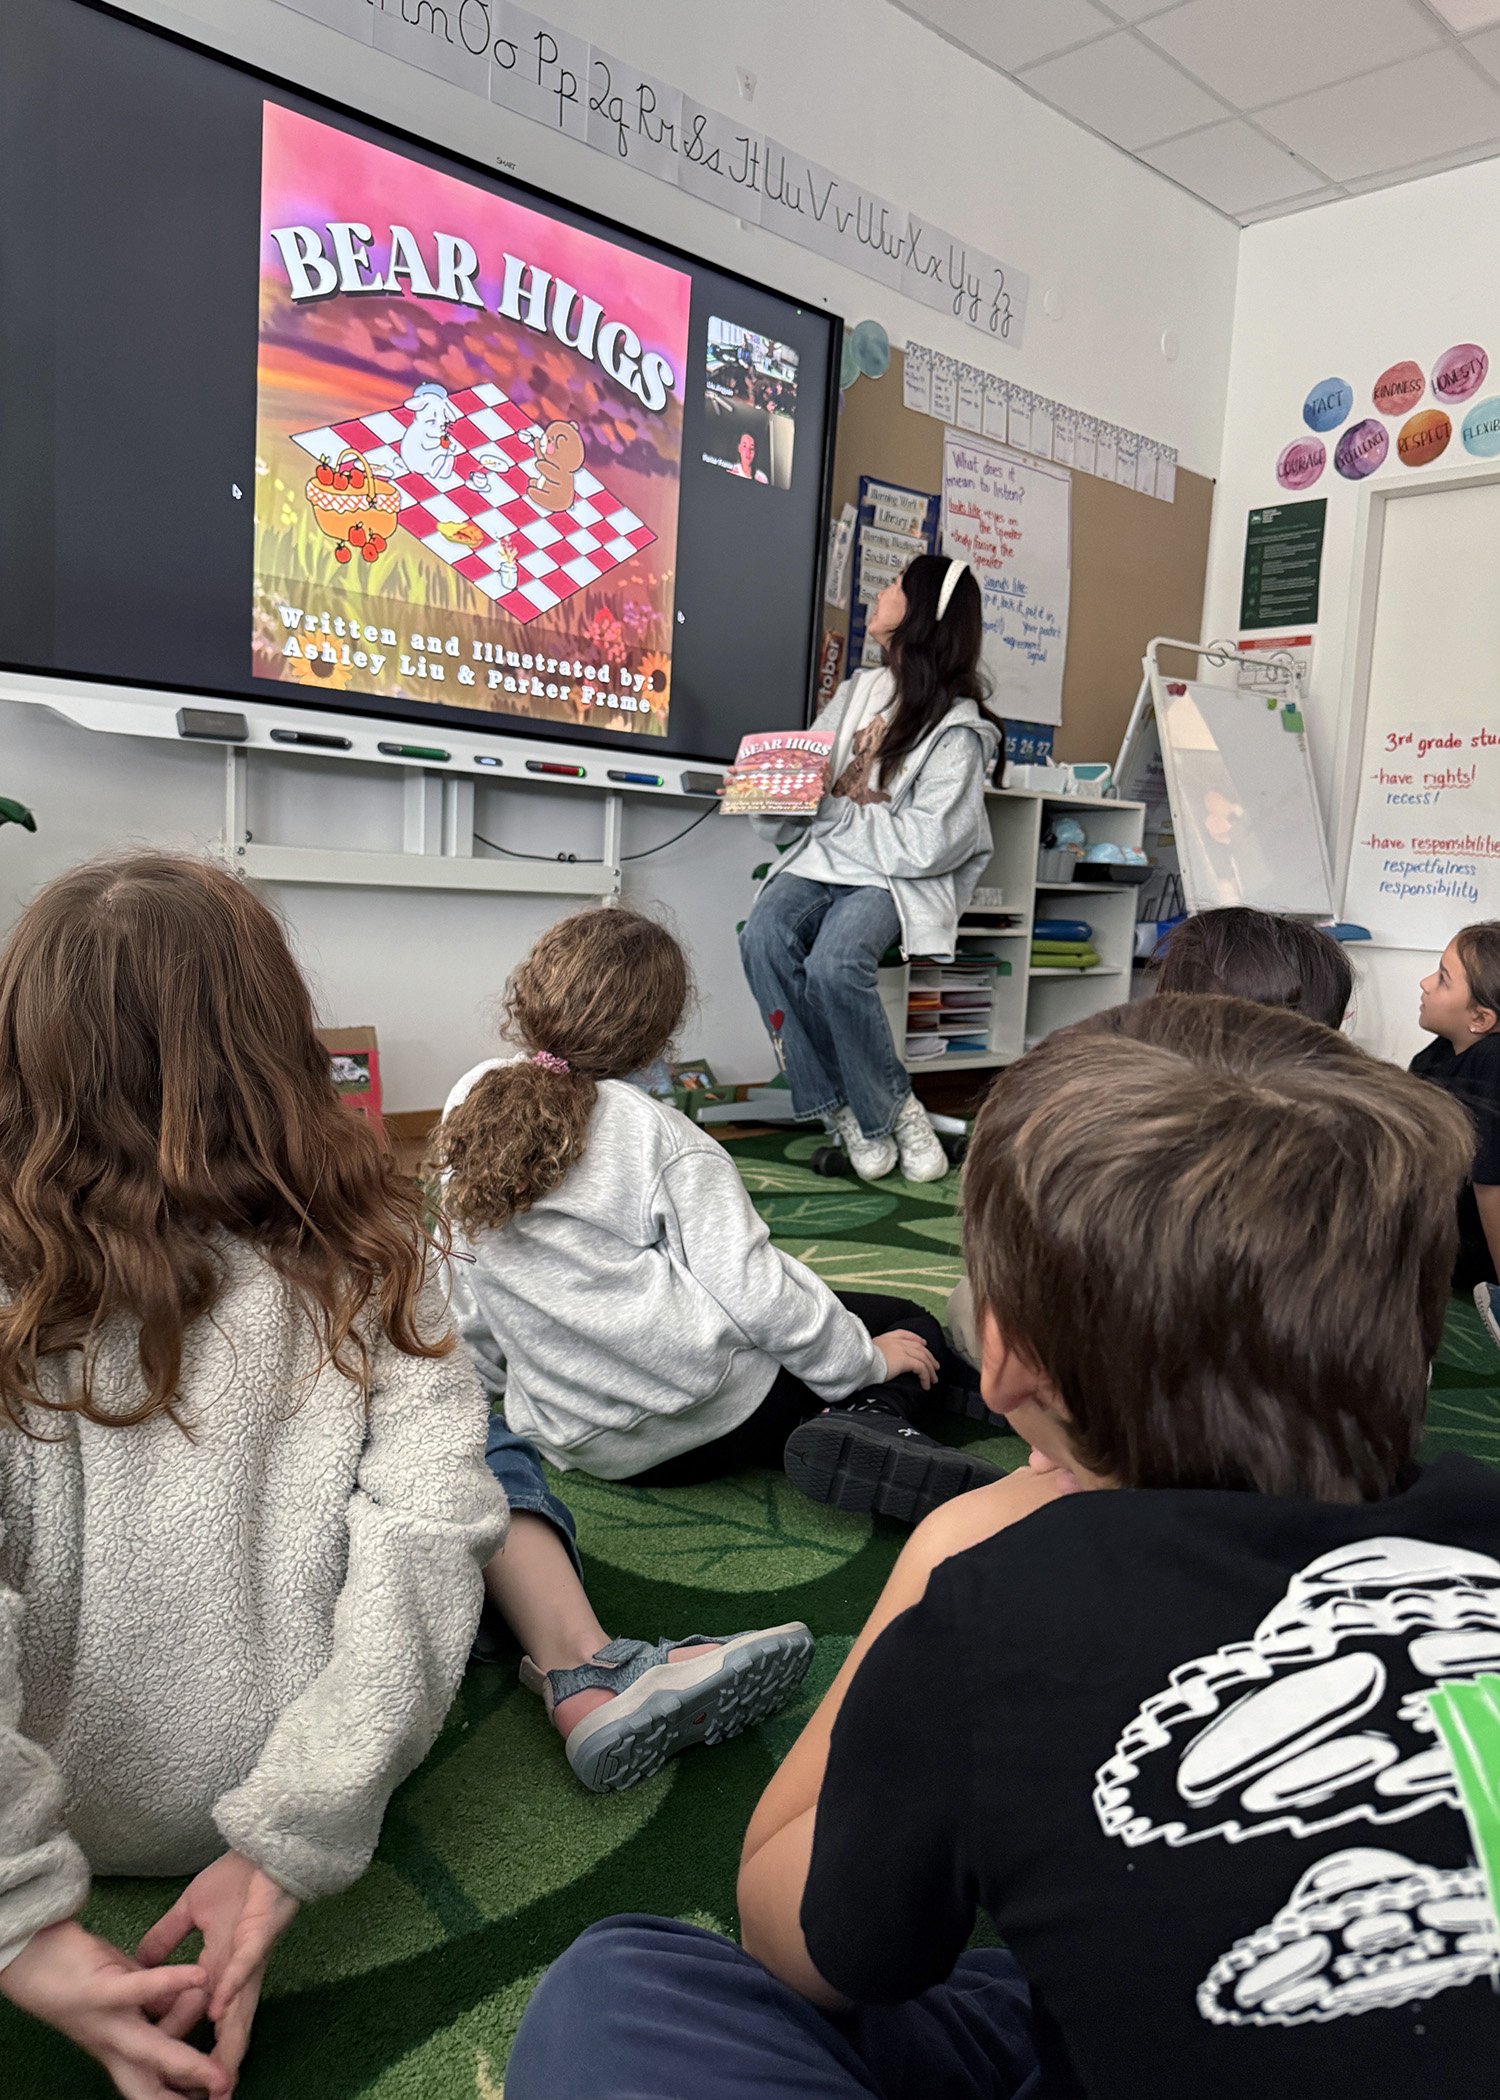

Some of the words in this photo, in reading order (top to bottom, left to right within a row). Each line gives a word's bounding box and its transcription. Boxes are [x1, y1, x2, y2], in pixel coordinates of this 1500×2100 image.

[534, 31, 578, 127] Pp
[271, 222, 484, 305] BEAR
[497, 252, 675, 411] HUGS
[1431, 354, 1486, 394] HONESTY
[1373, 378, 1421, 400] KINDNESS
[1311, 391, 1344, 415] TACT
[1398, 422, 1450, 452] RESPECT
[952, 451, 978, 473] What
[983, 460, 1003, 478] does
[1008, 467, 1015, 482] it
[1278, 448, 1325, 477] COURAGE
[945, 477, 975, 489] mean
[980, 477, 990, 492] to
[279, 605, 397, 646] Written
[410, 632, 460, 658] and
[471, 640, 610, 684] Illustrated
[620, 668, 655, 692] by:
[282, 635, 386, 675] Ashley
[400, 654, 446, 681] Liu
[457, 664, 476, 686] &
[488, 669, 571, 701] Parker
[581, 685, 651, 714] Frame
[741, 740, 782, 760] BEAR
[786, 738, 832, 756] HUGS
[1020, 739, 1034, 754] 26
[1036, 741, 1051, 757] 27
[1385, 732, 1412, 752] 3rd
[1417, 732, 1462, 758] grade
[1471, 727, 1500, 747] stu
[1424, 764, 1476, 788] rights!
[1386, 791, 1440, 805] recess!
[1383, 859, 1477, 878] respectfulness
[1379, 878, 1478, 904] responsibility
